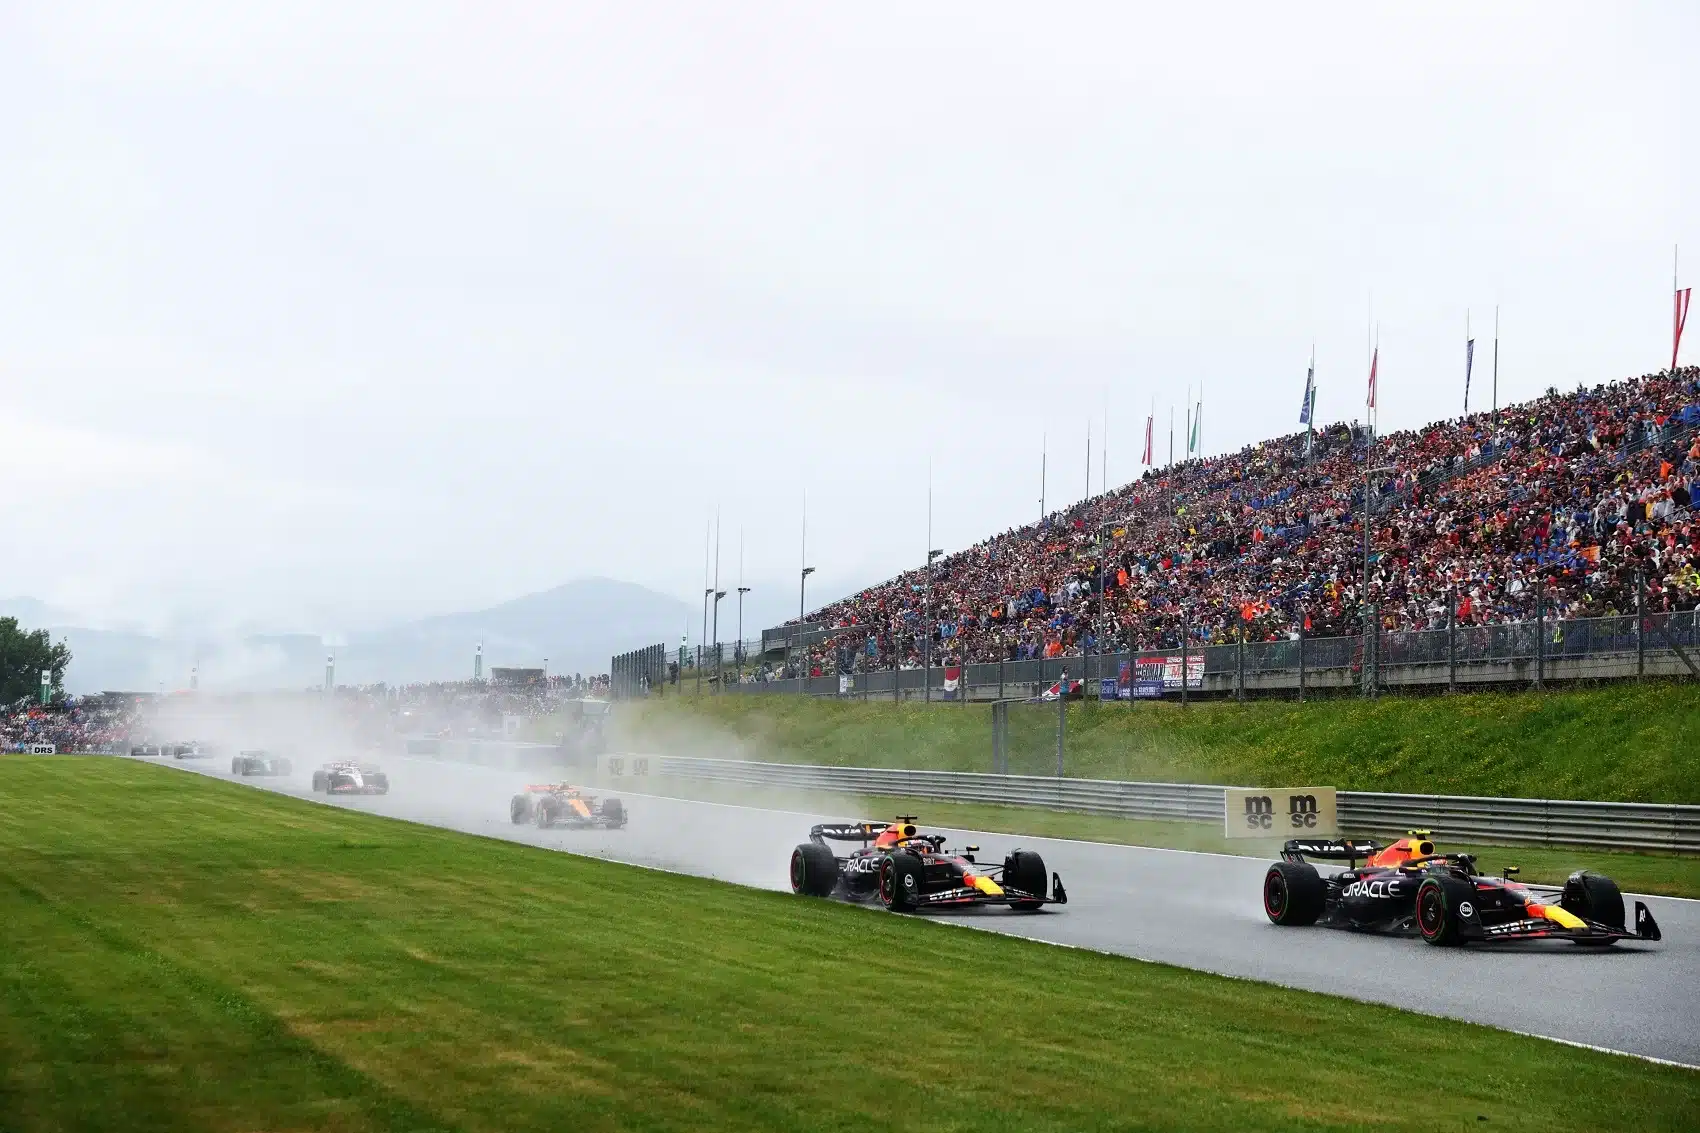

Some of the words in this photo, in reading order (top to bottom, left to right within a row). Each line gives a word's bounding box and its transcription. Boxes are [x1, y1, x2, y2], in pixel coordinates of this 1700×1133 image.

[34, 746, 53, 754] DRS
[1243, 796, 1276, 815] m
[1286, 795, 1321, 815] m
[1246, 814, 1273, 829] sc
[1290, 813, 1317, 828] sc
[1342, 880, 1404, 899] ORACLE
[1639, 909, 1646, 923] A1
